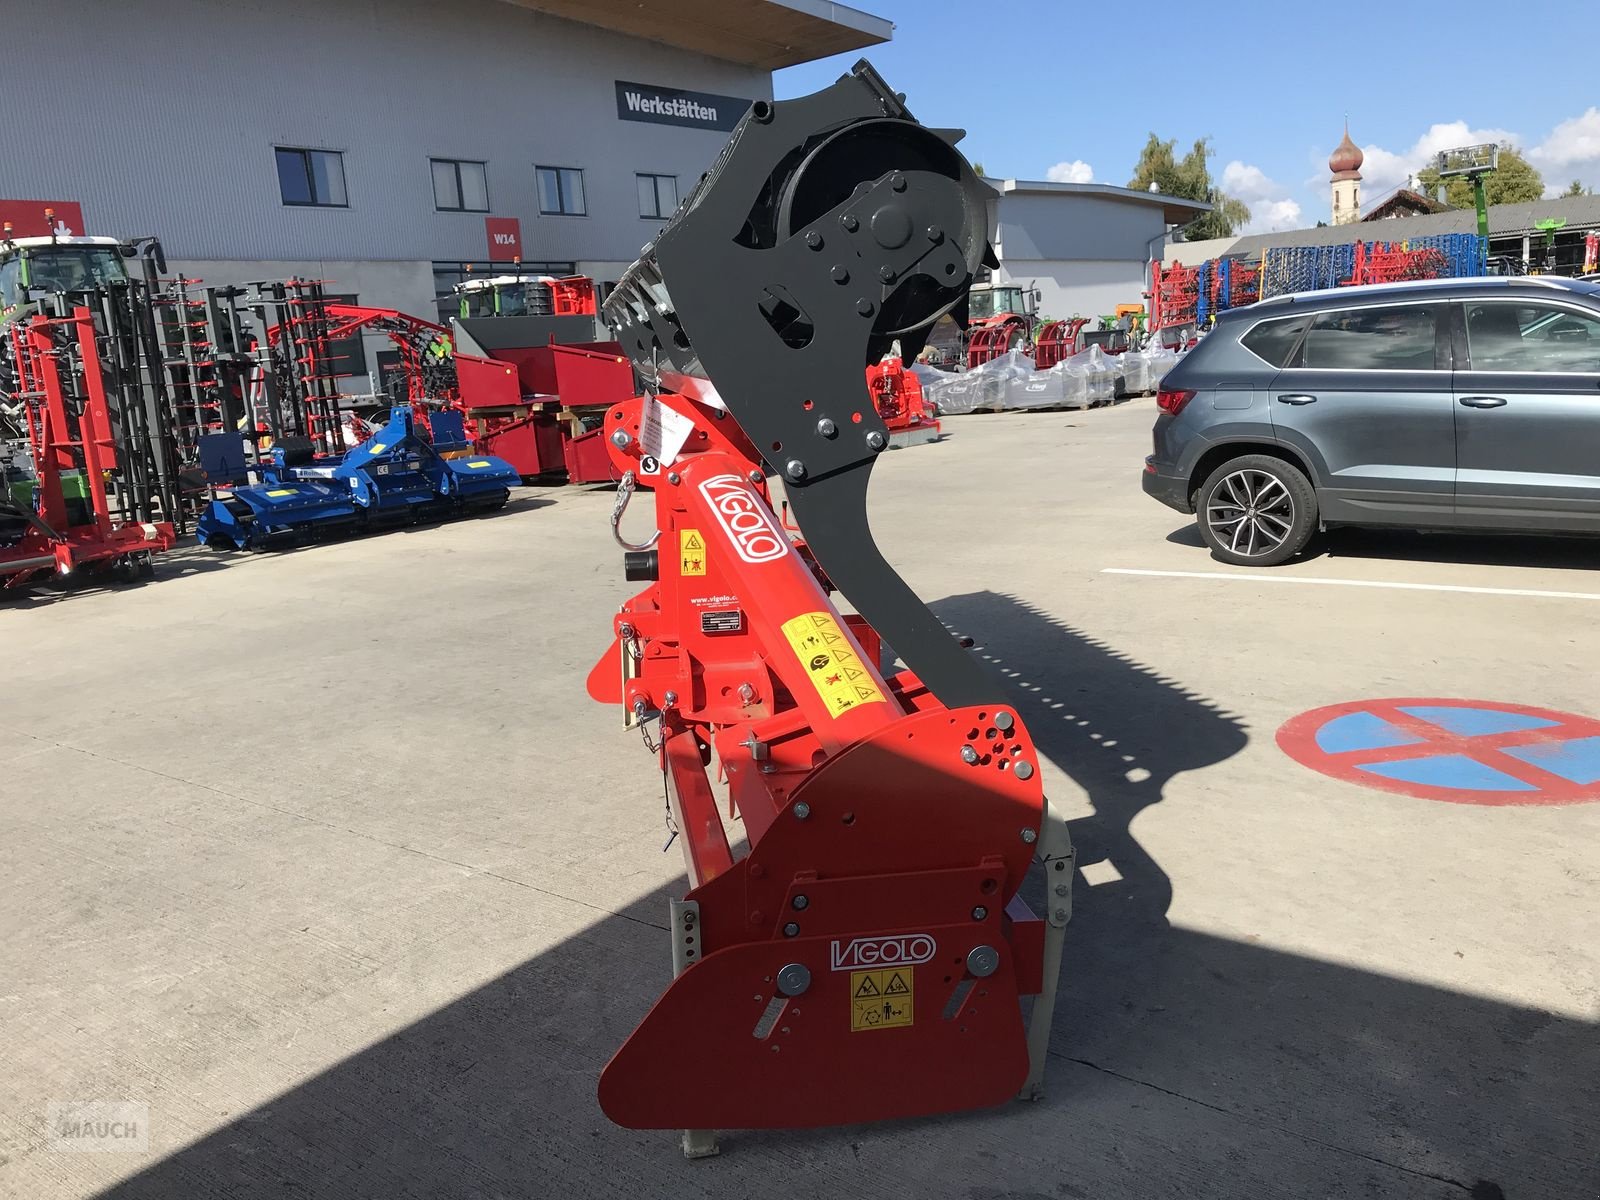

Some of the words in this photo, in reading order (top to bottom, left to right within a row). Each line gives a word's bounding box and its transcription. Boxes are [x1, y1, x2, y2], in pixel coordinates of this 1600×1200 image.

[625, 92, 717, 121] Werkstätten
[493, 233, 516, 245] W14
[304, 469, 331, 478] Rolma
[702, 475, 782, 557] VIGOLO
[834, 938, 933, 967] VIGOLO
